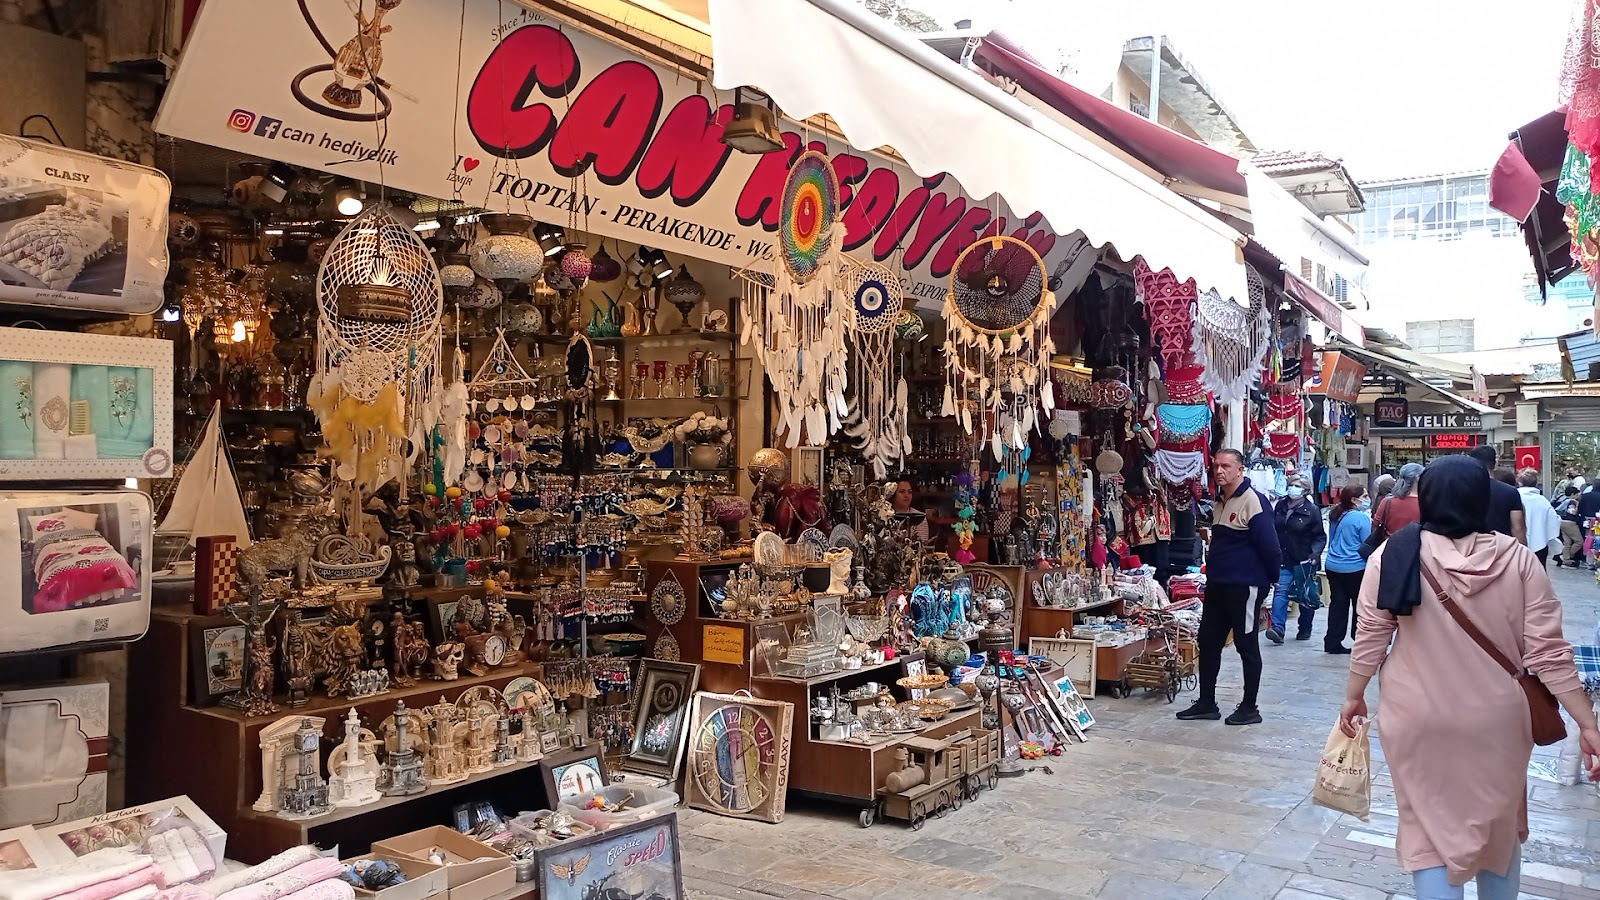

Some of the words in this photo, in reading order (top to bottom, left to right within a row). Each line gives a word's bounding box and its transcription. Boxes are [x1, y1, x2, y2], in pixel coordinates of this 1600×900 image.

[491, 18, 518, 42] Since
[467, 25, 735, 208] CAN
[281, 127, 315, 145] can
[319, 132, 399, 166] hediyelik
[452, 155, 464, 171] I
[45, 167, 90, 184] CLASY
[491, 171, 601, 217] TOPTAN
[611, 204, 736, 251] PERAKENDE
[911, 282, 948, 301] EXPOR
[1380, 406, 1403, 418] TAÇ
[1407, 413, 1458, 428] İYELİK
[1059, 643, 1068, 652] 12
[728, 712, 739, 724] 12
[713, 720, 724, 733] 11
[759, 727, 769, 738] 2
[703, 736, 712, 751] 10
[766, 748, 775, 757] 3
[778, 737, 789, 787] GALAXY
[722, 790, 730, 801] 7
[607, 838, 641, 866] Classic
[624, 828, 667, 868] SPEED
